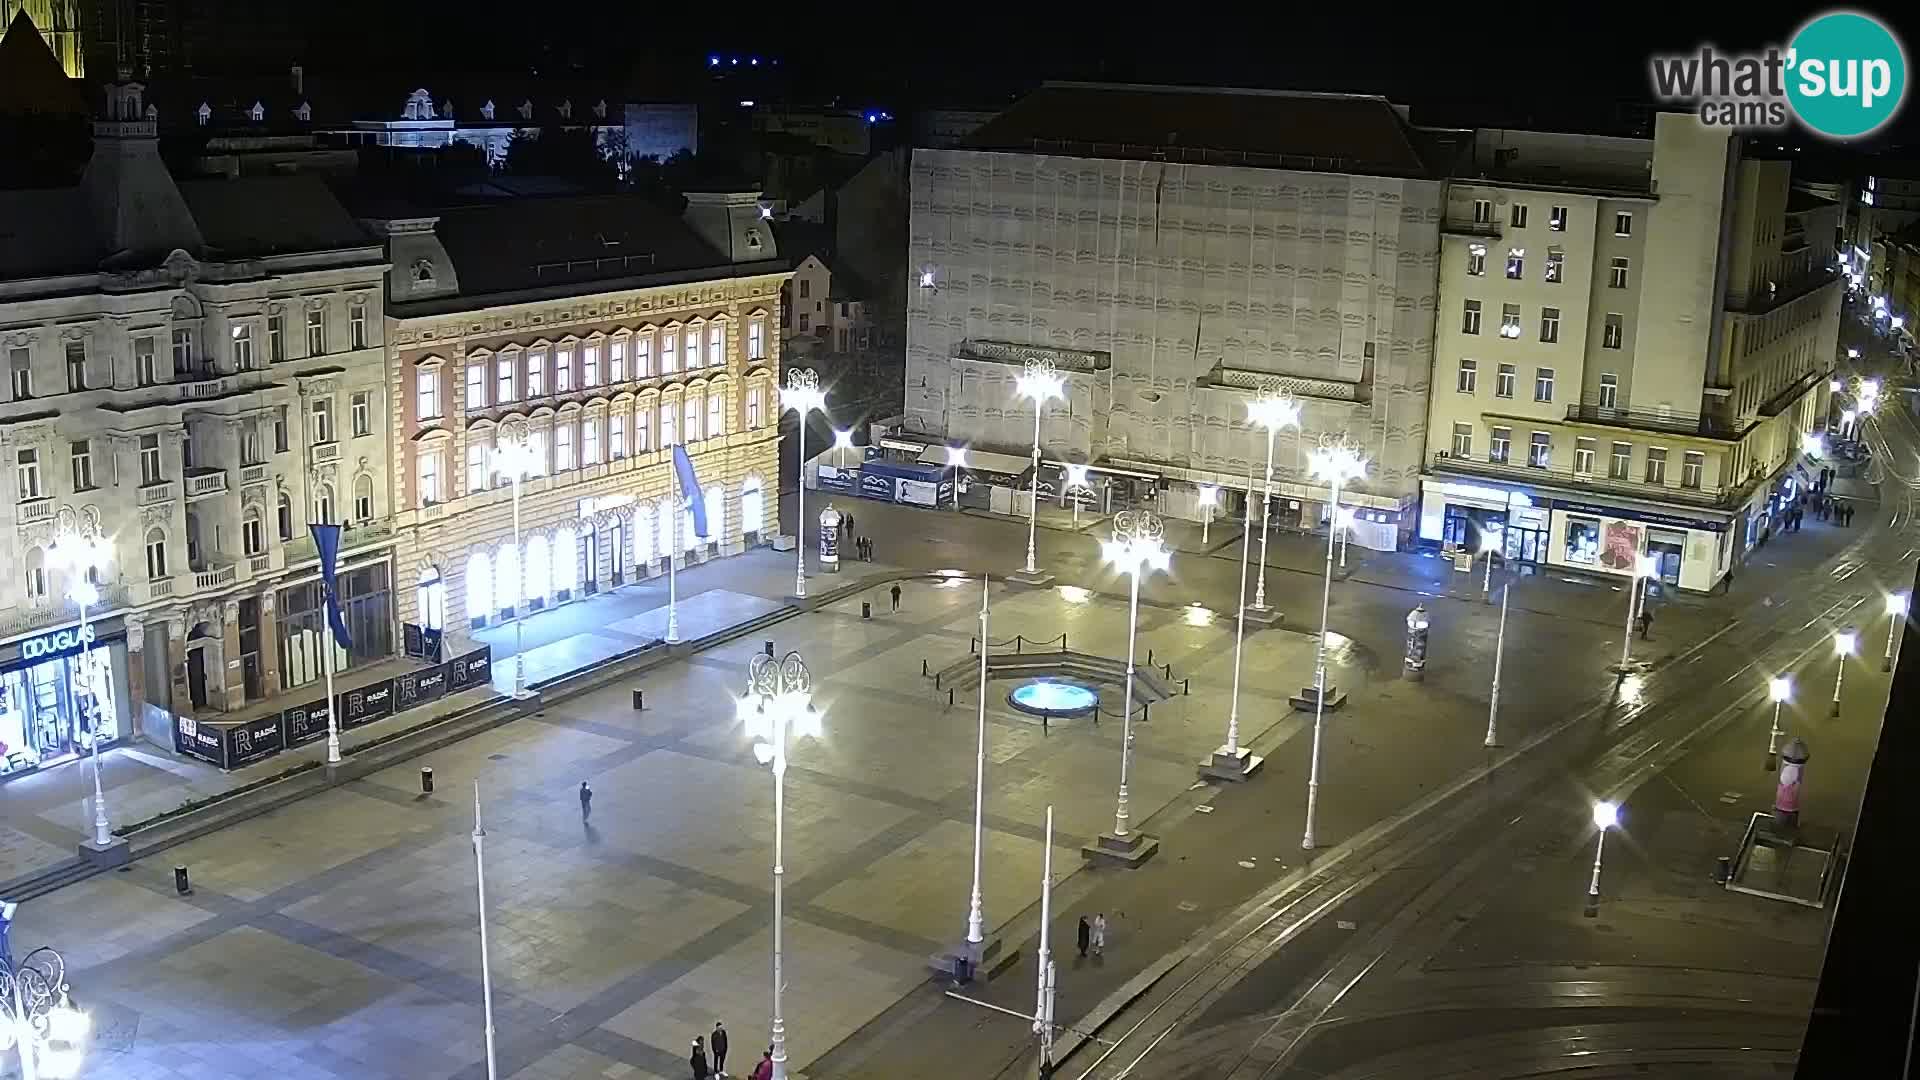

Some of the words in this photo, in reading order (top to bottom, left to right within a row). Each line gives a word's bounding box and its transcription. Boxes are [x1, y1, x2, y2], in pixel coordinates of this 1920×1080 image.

[22, 624, 95, 659] DOUGLAS
[350, 693, 364, 716] R
[291, 710, 308, 732] R
[234, 729, 253, 754] R
